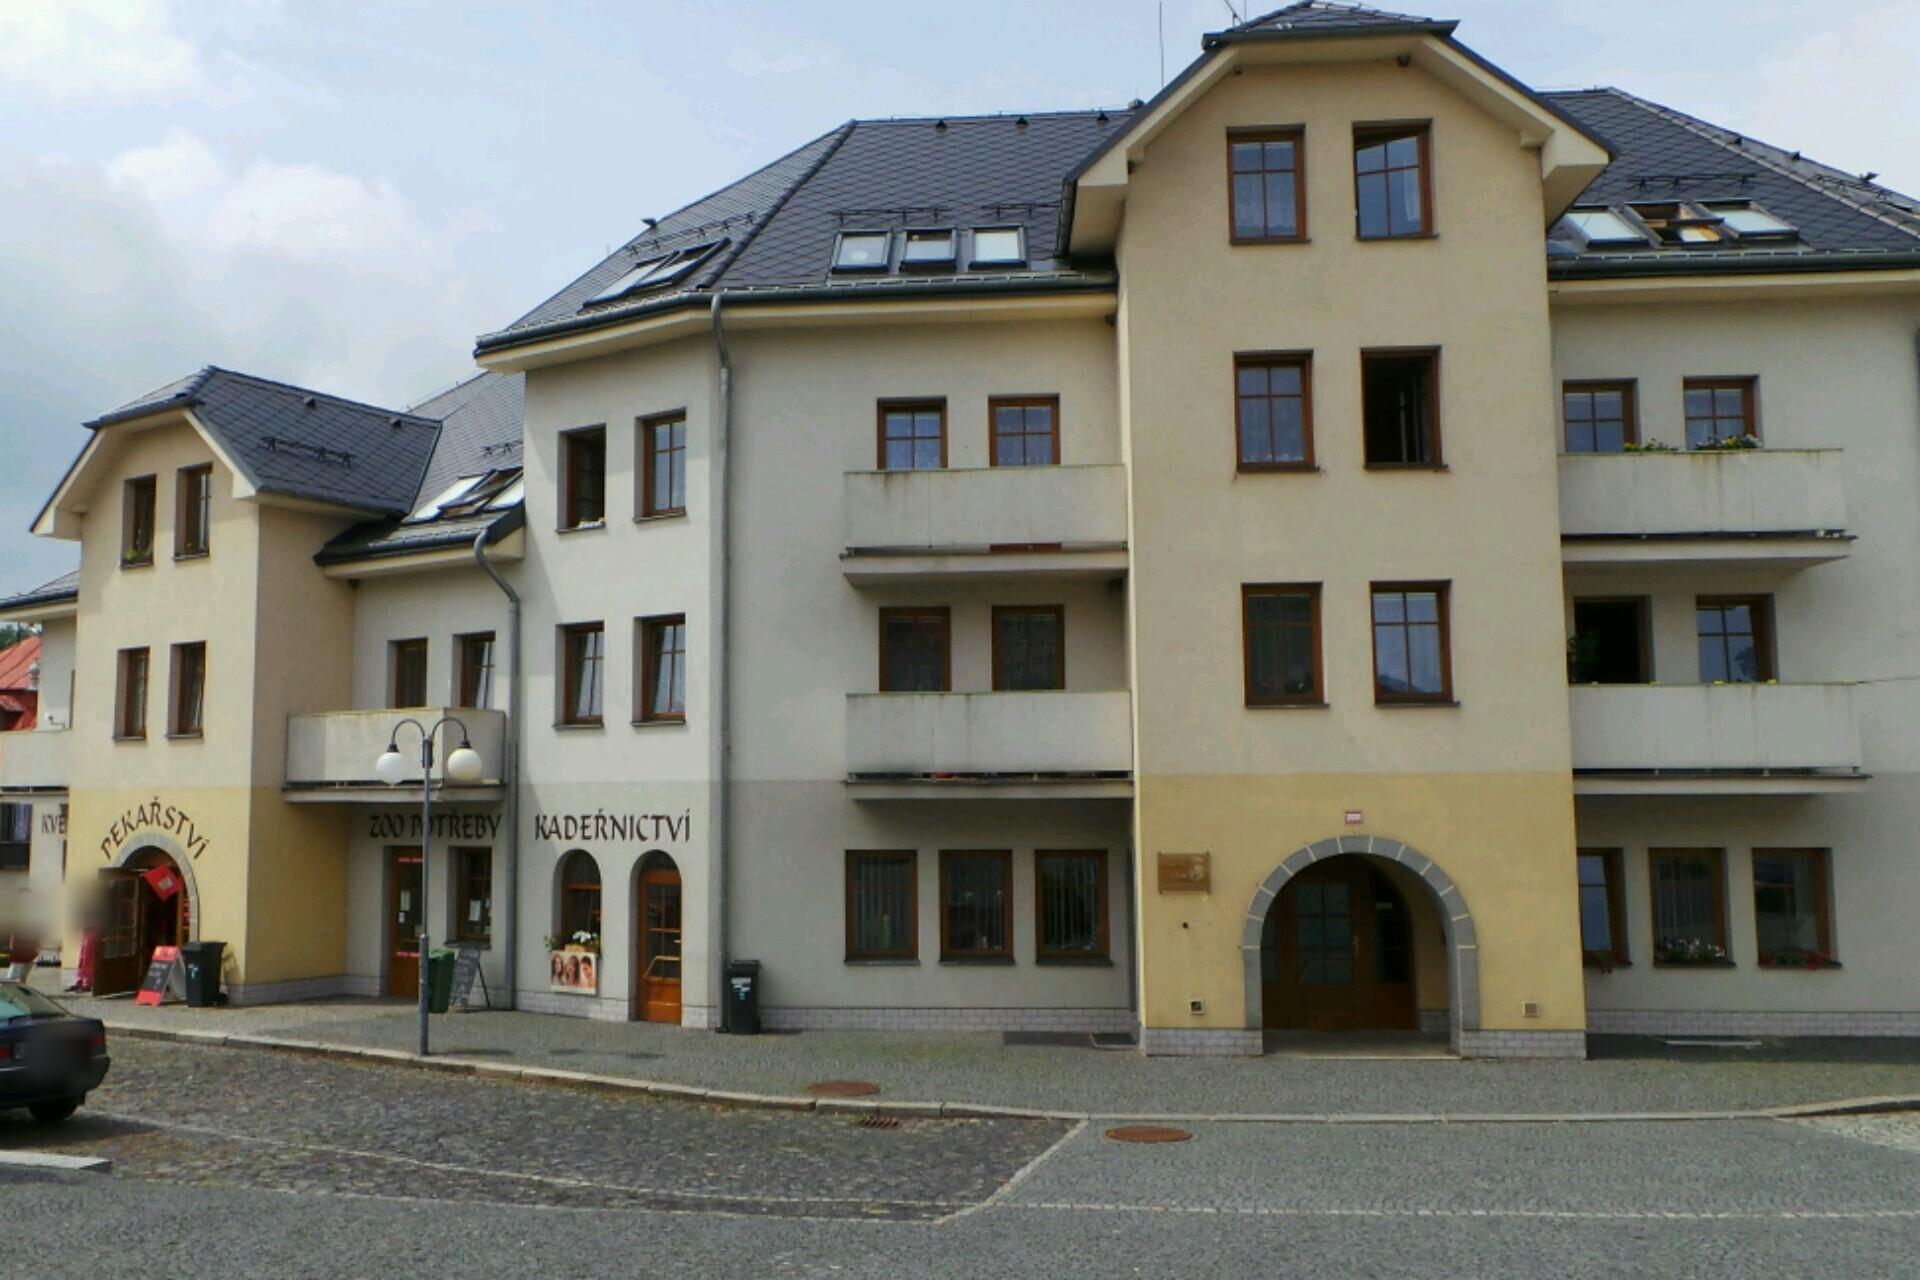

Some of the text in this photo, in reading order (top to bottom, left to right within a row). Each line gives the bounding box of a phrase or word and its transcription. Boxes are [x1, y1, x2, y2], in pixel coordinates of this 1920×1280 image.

[101, 796, 210, 860] PEKAŘSTVÍ
[369, 813, 405, 839] ZOO
[535, 808, 691, 843] KADEŘNICTVÍ
